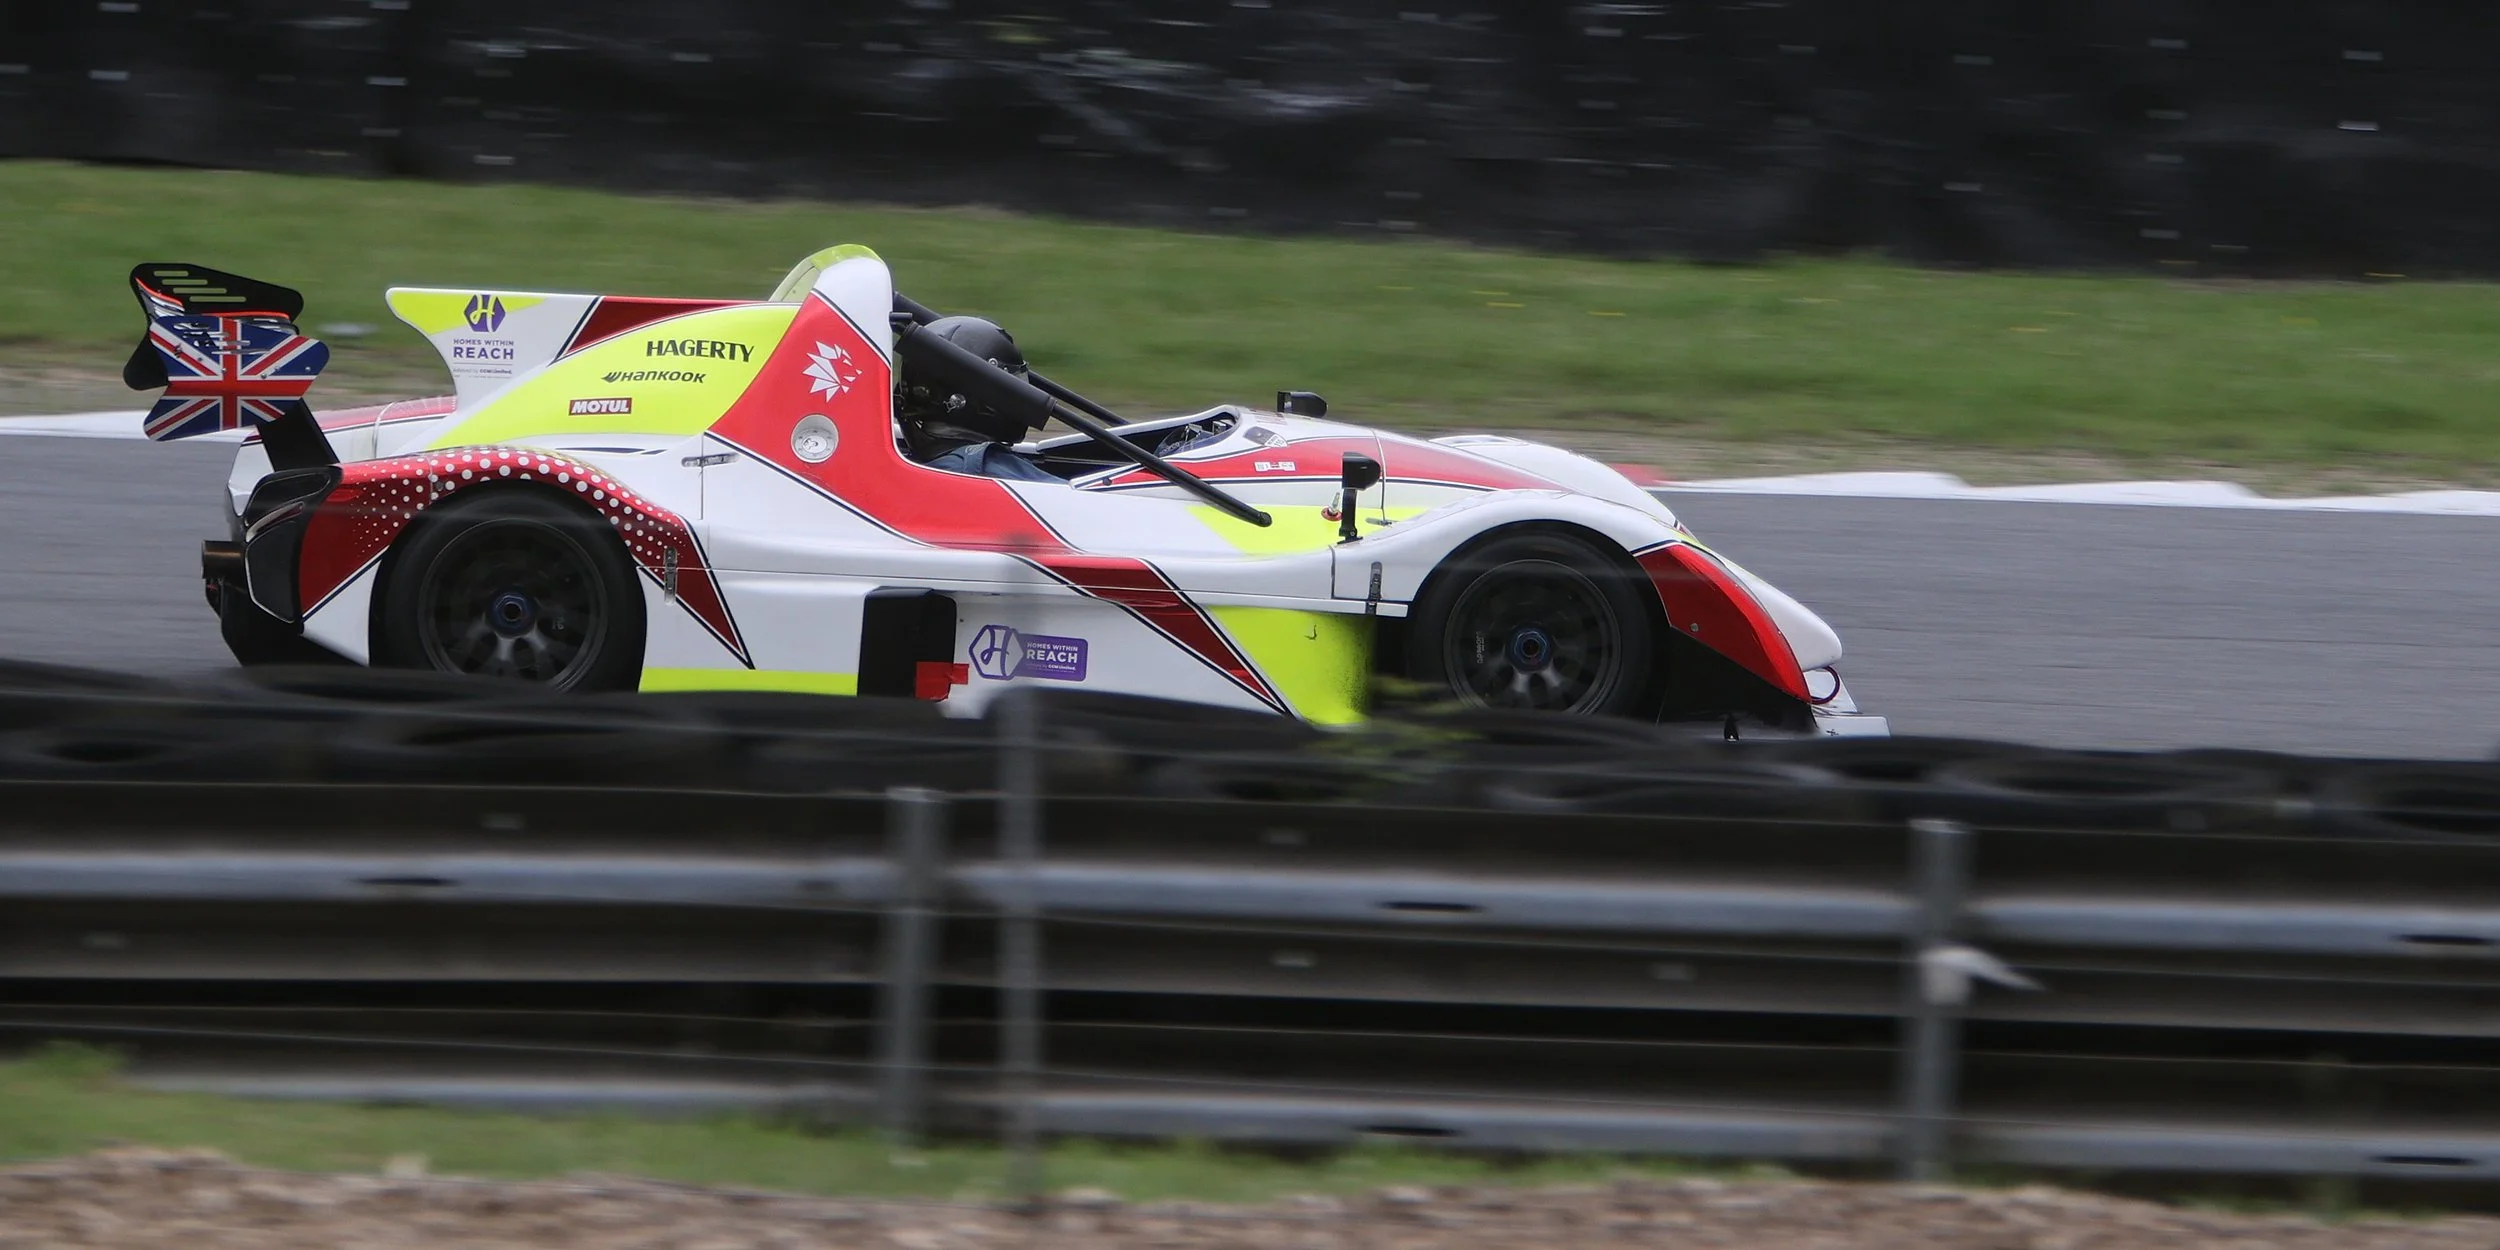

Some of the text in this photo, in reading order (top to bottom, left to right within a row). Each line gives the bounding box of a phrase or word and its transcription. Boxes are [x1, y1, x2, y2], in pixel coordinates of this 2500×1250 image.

[453, 346, 514, 360] REACH
[646, 339, 755, 363] HAGERTY
[571, 400, 629, 413] MOTUL
[1052, 644, 1079, 652] WITHIN
[1026, 649, 1078, 664] REACH
